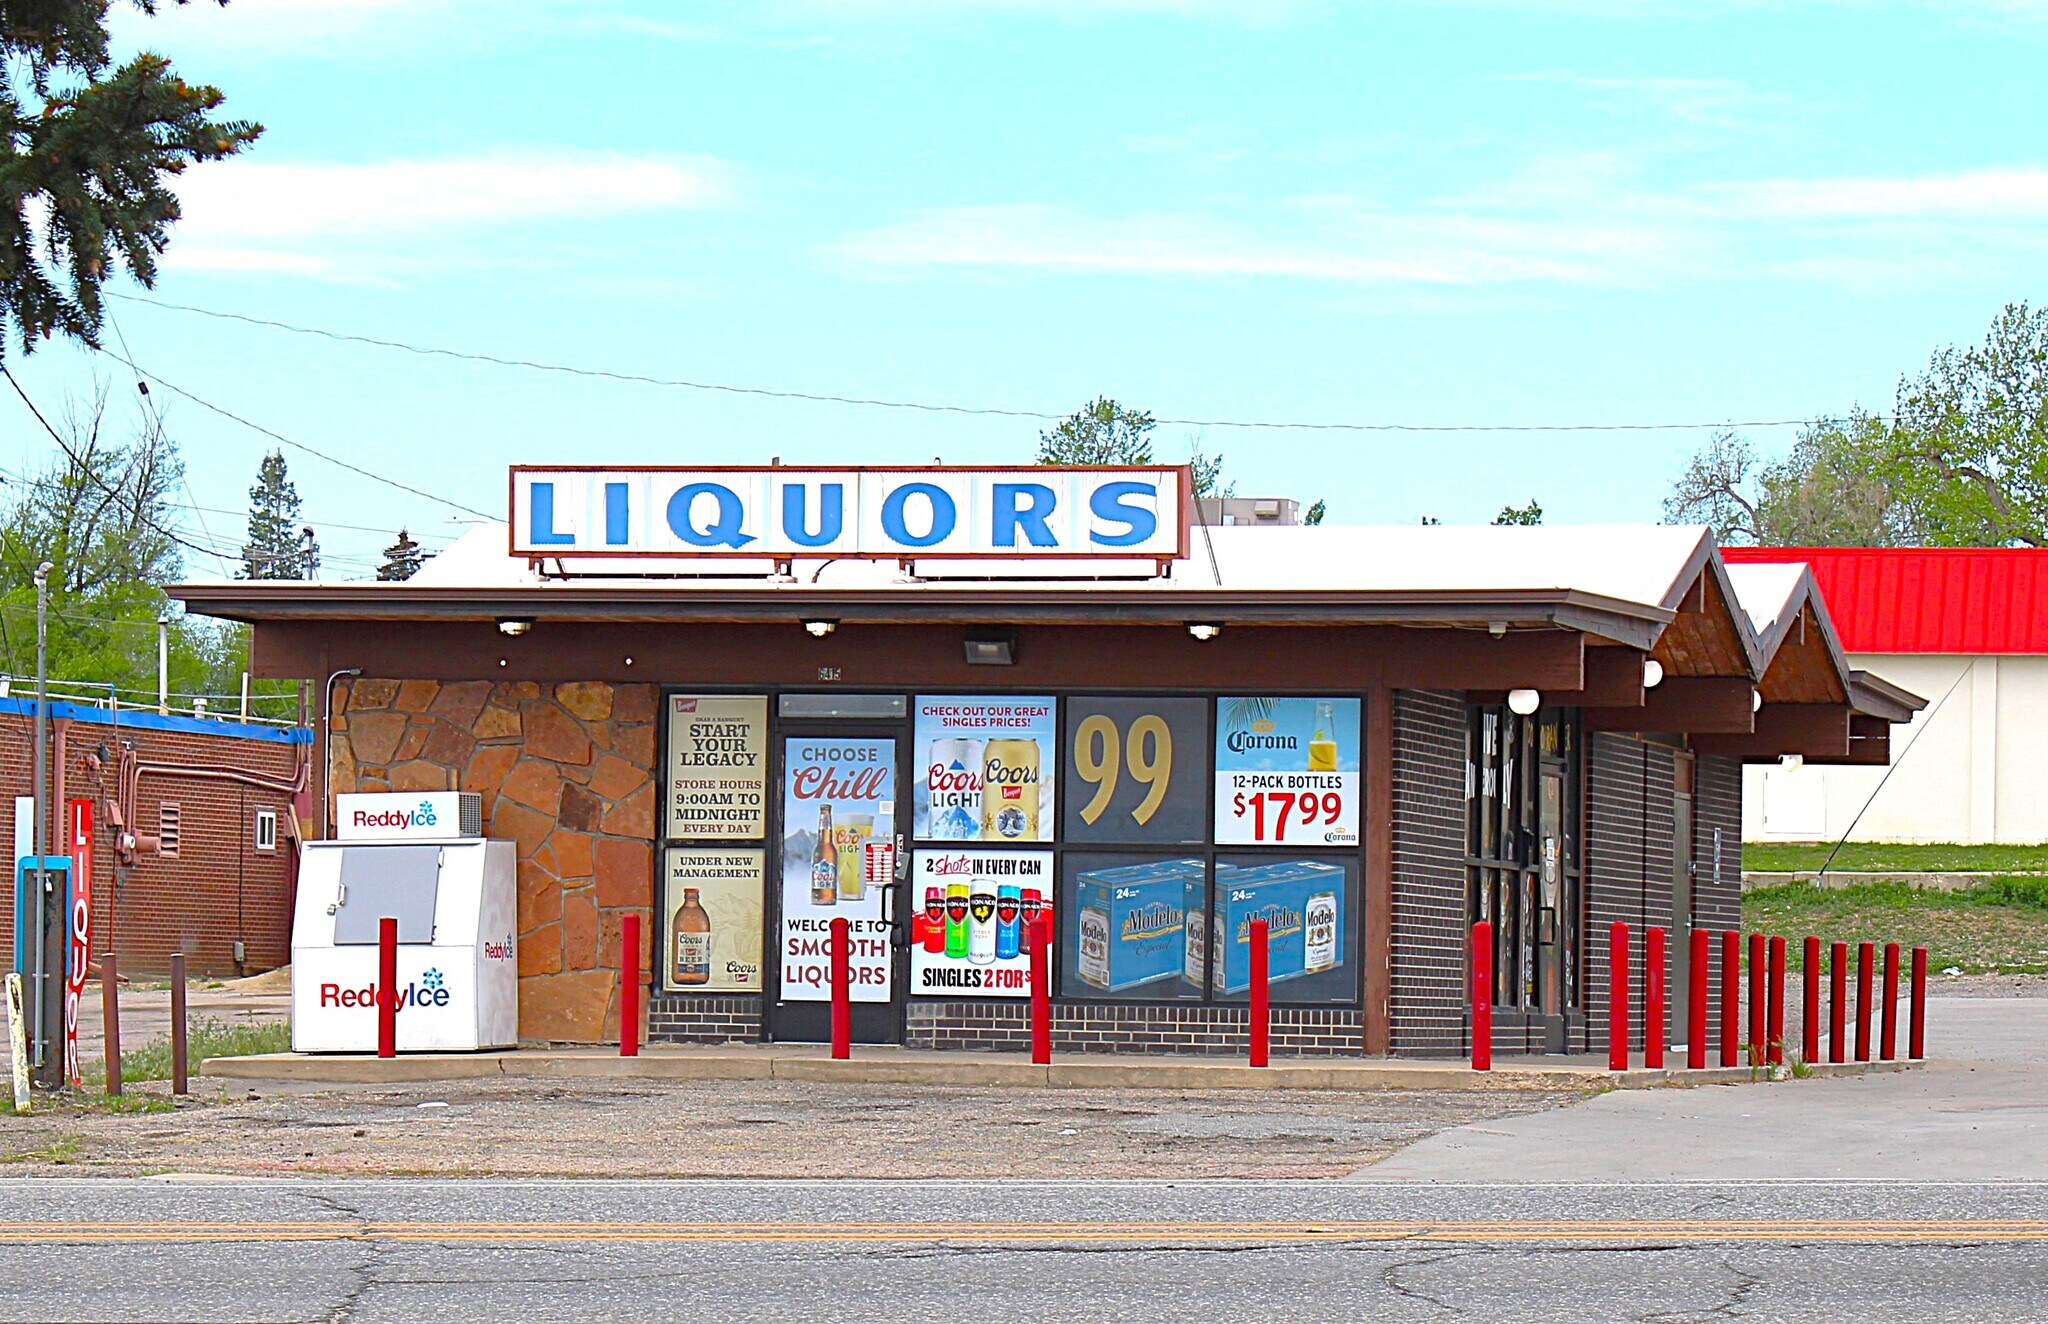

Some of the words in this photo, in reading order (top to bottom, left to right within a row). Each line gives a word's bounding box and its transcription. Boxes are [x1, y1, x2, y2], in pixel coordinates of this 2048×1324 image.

[531, 481, 1158, 549] LIQUORS
[922, 706, 960, 716] CHECK
[962, 707, 985, 716] OUT
[988, 707, 1012, 717] OUR
[1014, 707, 1049, 717] GREAT
[942, 718, 987, 727] SINGLES
[989, 718, 1031, 727] PRICES!
[690, 724, 750, 737] START
[692, 739, 747, 752] YOUR
[1227, 730, 1298, 755] Corona
[681, 753, 758, 766] LEGACY
[801, 747, 877, 761] CHOOSE
[986, 758, 1038, 784] Coors
[1074, 714, 1172, 826] 99
[675, 780, 716, 789] STORE
[719, 780, 762, 789] HOURS
[793, 766, 888, 800] Chill
[1232, 775, 1284, 788] 12-PACK
[1288, 775, 1342, 788] BOTTLES
[676, 793, 733, 805] 9:00AM
[738, 794, 760, 805] TO
[933, 792, 980, 807] LIGHT
[675, 808, 760, 820] MIDNIGHT
[683, 824, 723, 833] EVERY
[727, 825, 752, 833] DAY
[836, 830, 863, 845] Coo
[1324, 832, 1356, 843] Corona
[840, 845, 860, 853] LIGH
[680, 857, 722, 866] UNDER
[726, 857, 753, 866] NEW
[926, 858, 934, 873] 2
[935, 854, 973, 875] shots
[972, 859, 983, 875] IN
[986, 860, 1017, 875] EVERY
[1019, 860, 1041, 875] CAN
[673, 868, 759, 878] MANAGEMENT
[1116, 888, 1130, 899] 24
[1232, 890, 1246, 901] 24
[1129, 906, 1178, 931] Modelo
[1245, 908, 1294, 935] Mdelo
[1307, 908, 1334, 927] Modelo
[788, 919, 863, 932] WELCE
[867, 920, 886, 932] TO
[1081, 920, 1107, 943] Modelo
[680, 933, 702, 944] Coors
[726, 960, 758, 973] Coors
[922, 968, 982, 987] SINGLES
[984, 969, 994, 987] 2
[996, 969, 1024, 988] FOR
[321, 983, 450, 1013] RedyIce
